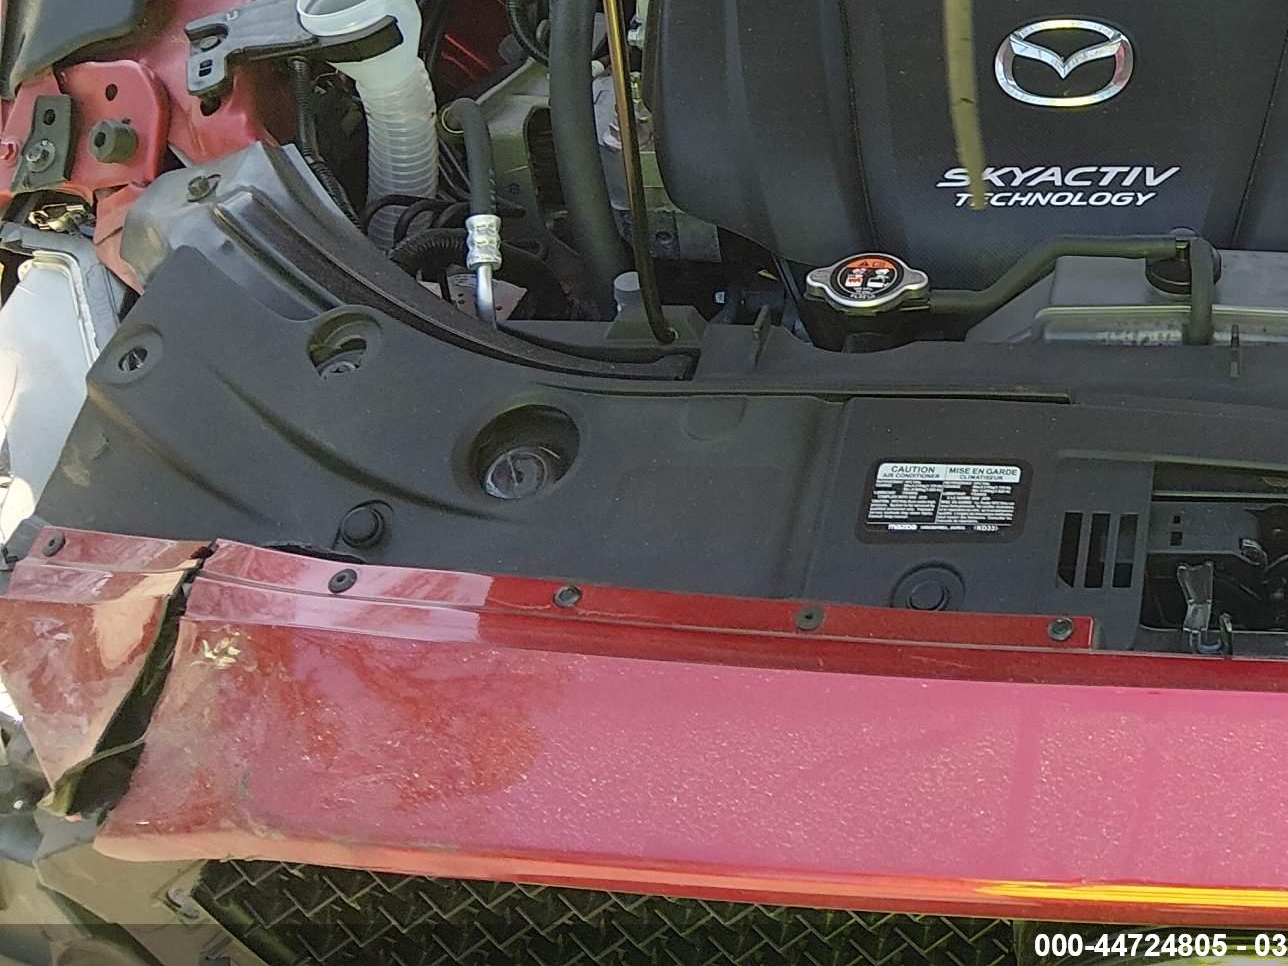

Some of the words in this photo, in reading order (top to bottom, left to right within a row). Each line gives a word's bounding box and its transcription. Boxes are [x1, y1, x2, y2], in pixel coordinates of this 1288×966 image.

[936, 166, 1180, 187] SKYACTIV
[891, 465, 936, 474] CAUTION
[949, 467, 971, 475] MISE
[985, 468, 1018, 476] GARDE
